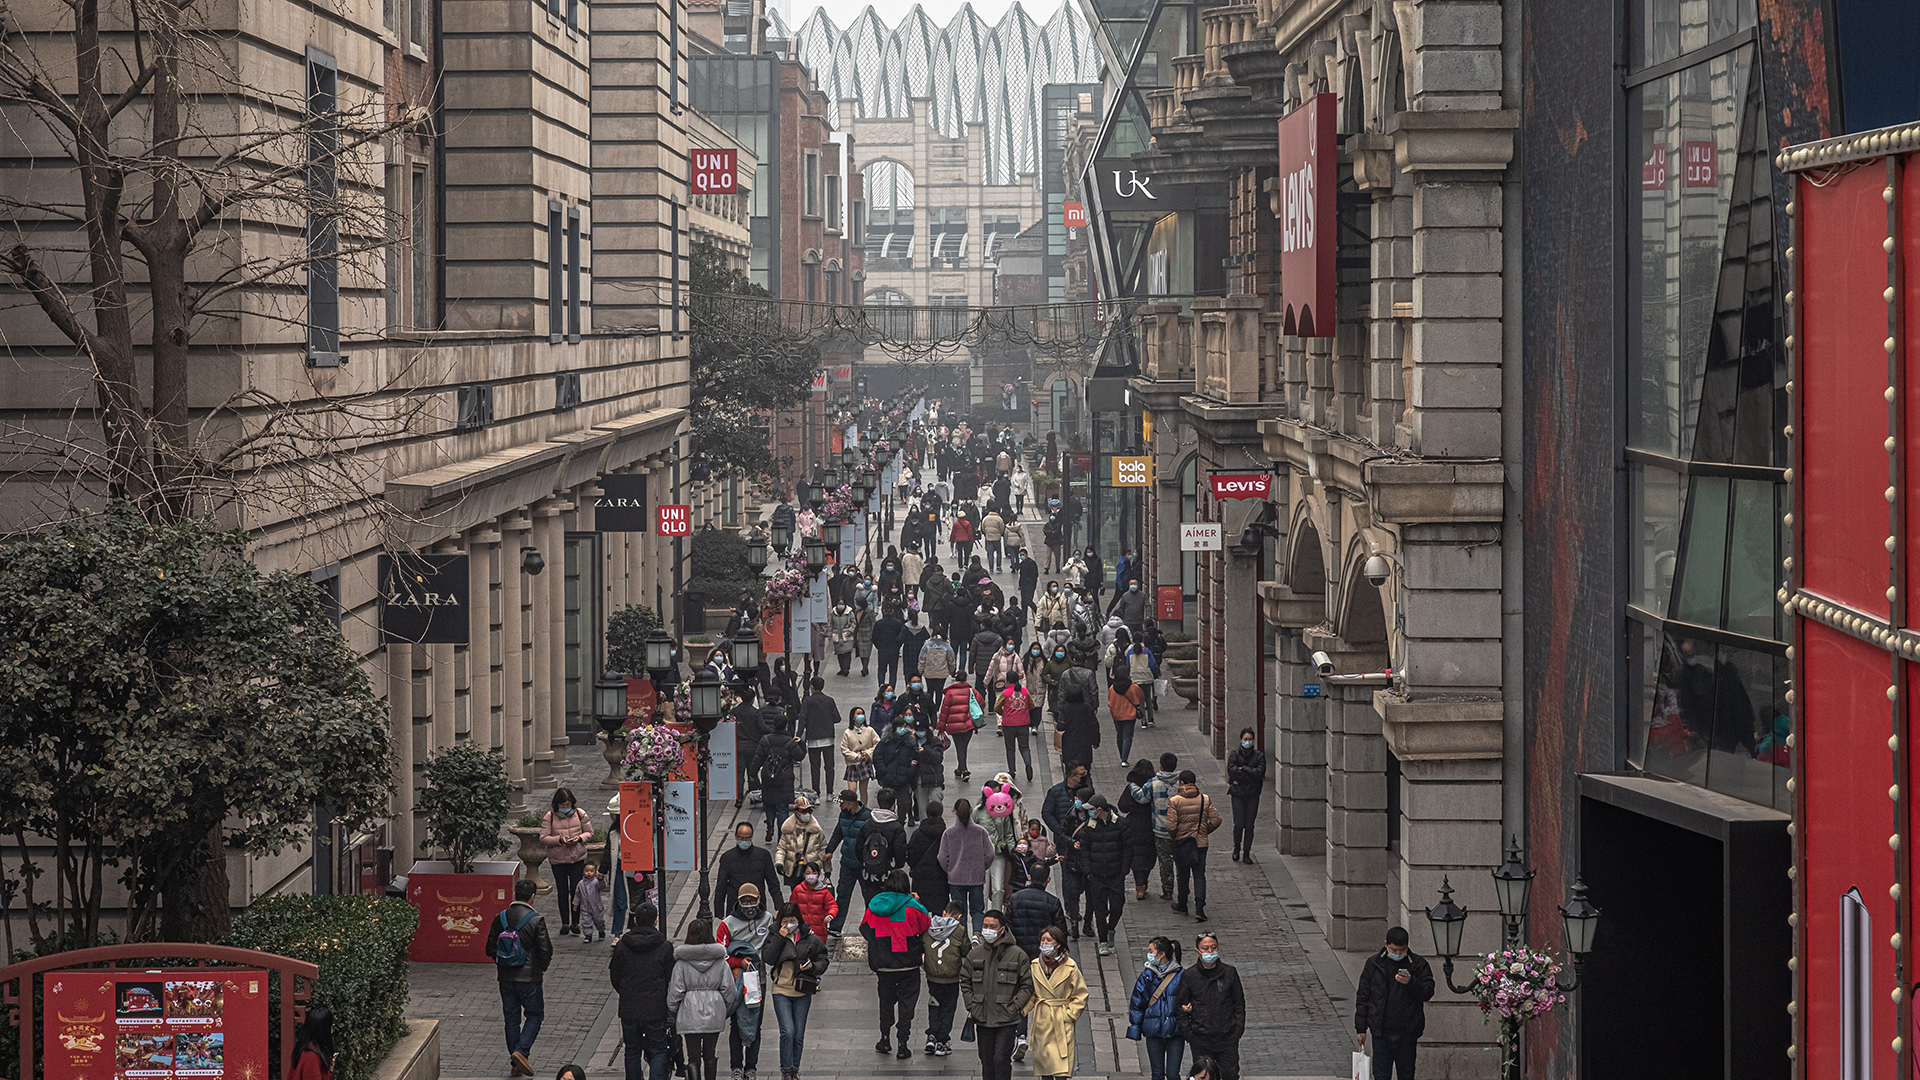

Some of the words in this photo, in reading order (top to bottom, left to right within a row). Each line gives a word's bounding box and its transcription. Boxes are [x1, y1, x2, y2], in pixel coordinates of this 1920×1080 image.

[696, 154, 728, 170] UNI
[696, 173, 732, 191] QLO
[1118, 460, 1146, 472] bala
[1118, 472, 1146, 483] bala
[594, 498, 641, 507] ZARA
[661, 508, 685, 520] UNI
[661, 521, 687, 534] QLO
[387, 592, 460, 606] ZARA
